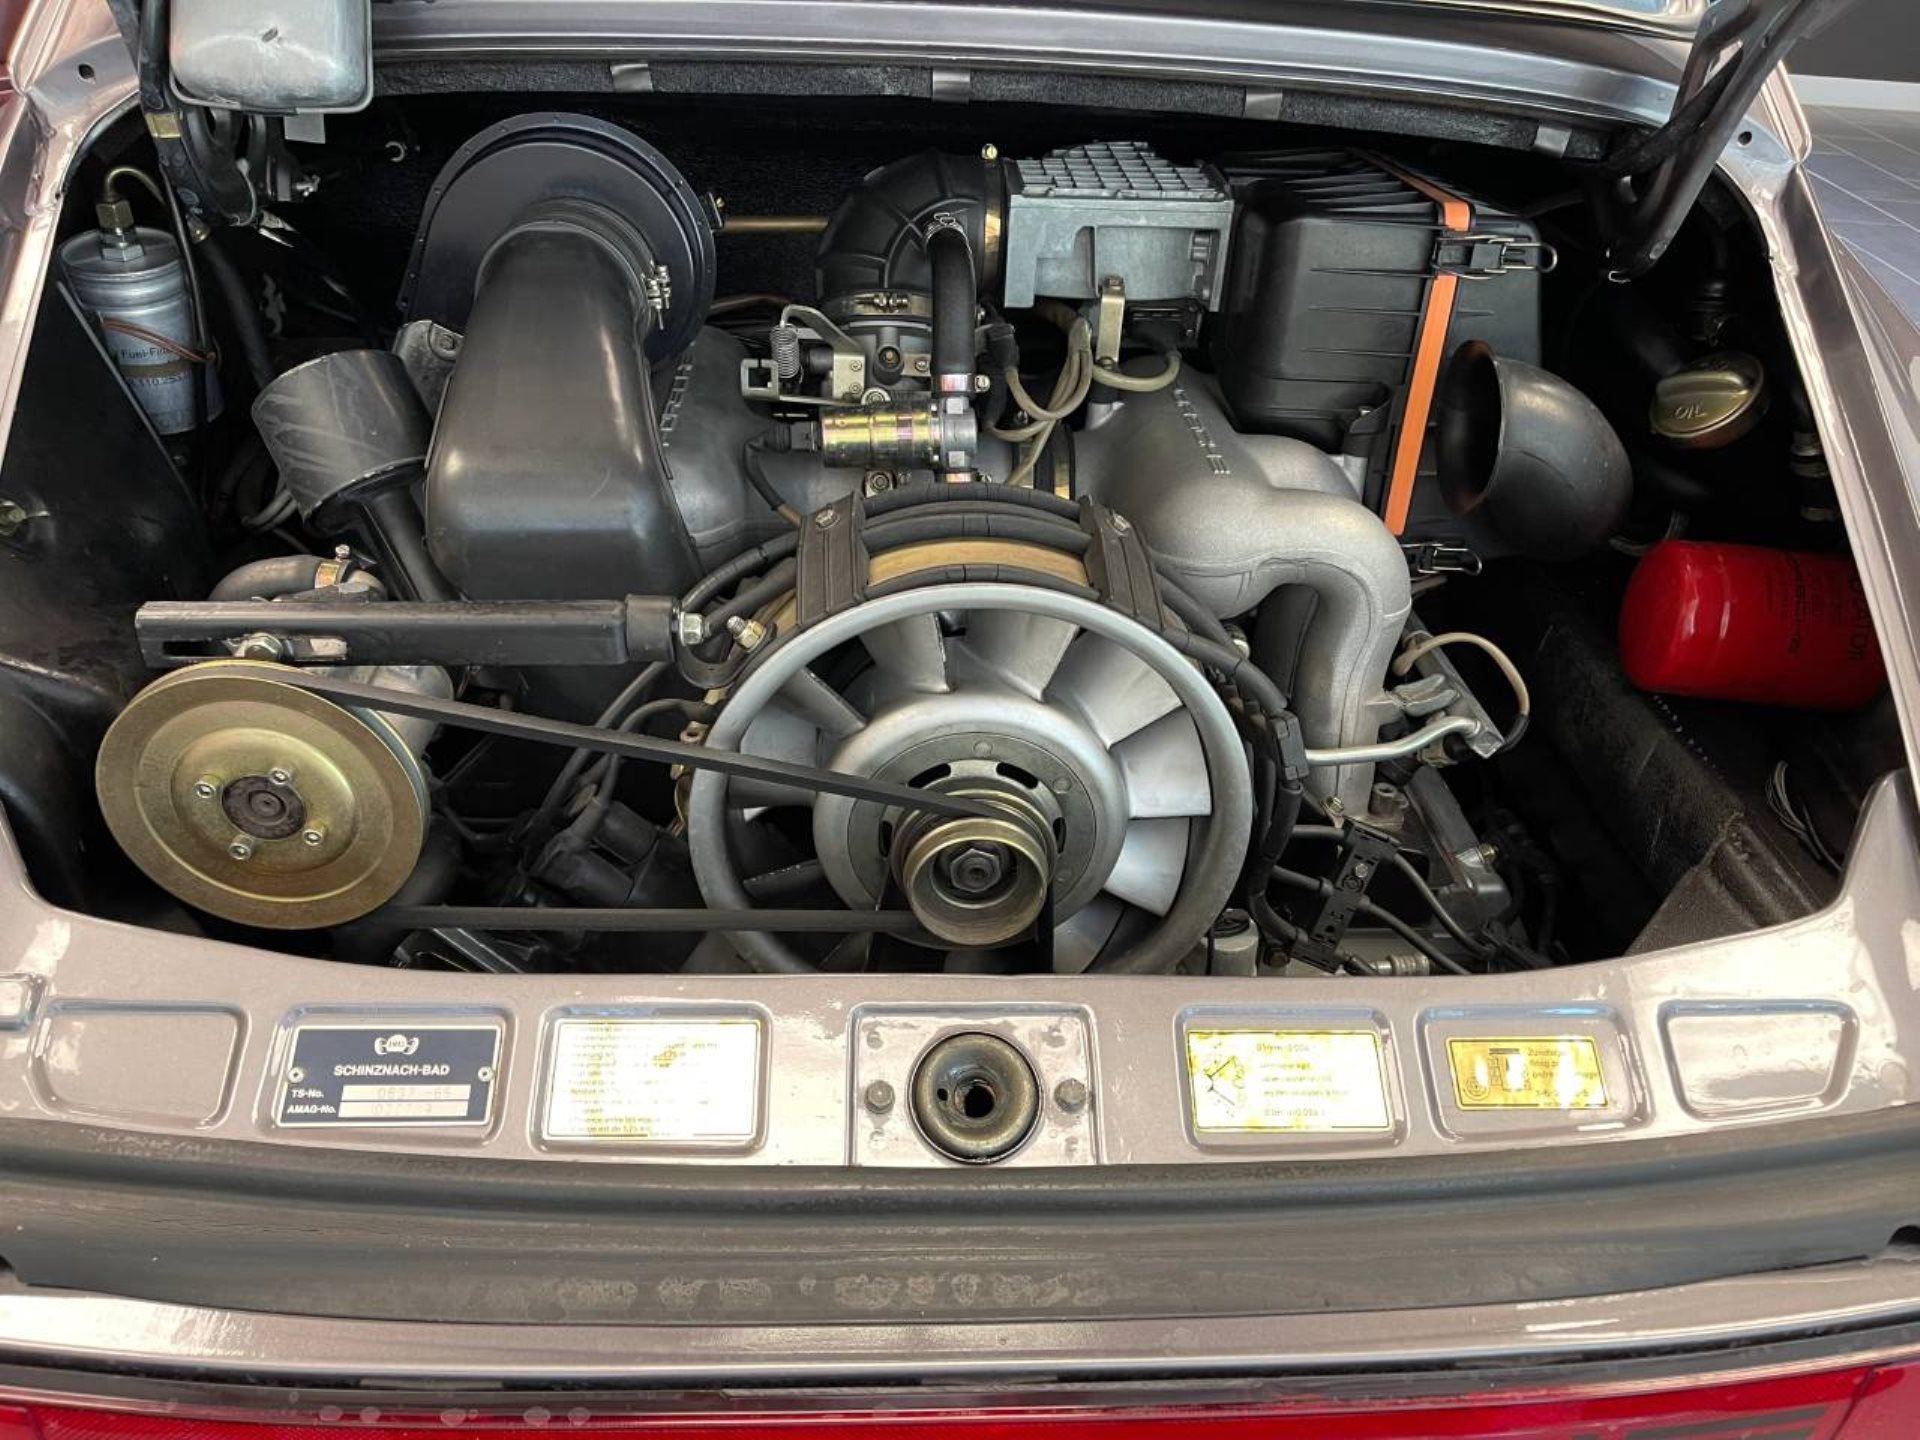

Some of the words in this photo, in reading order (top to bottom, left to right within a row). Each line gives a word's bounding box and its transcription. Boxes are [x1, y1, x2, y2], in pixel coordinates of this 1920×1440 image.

[333, 1063, 451, 1077] SCHINZNACH-BAD
[291, 1088, 325, 1099] TS-No.
[286, 1105, 337, 1115] AMAG-No.
